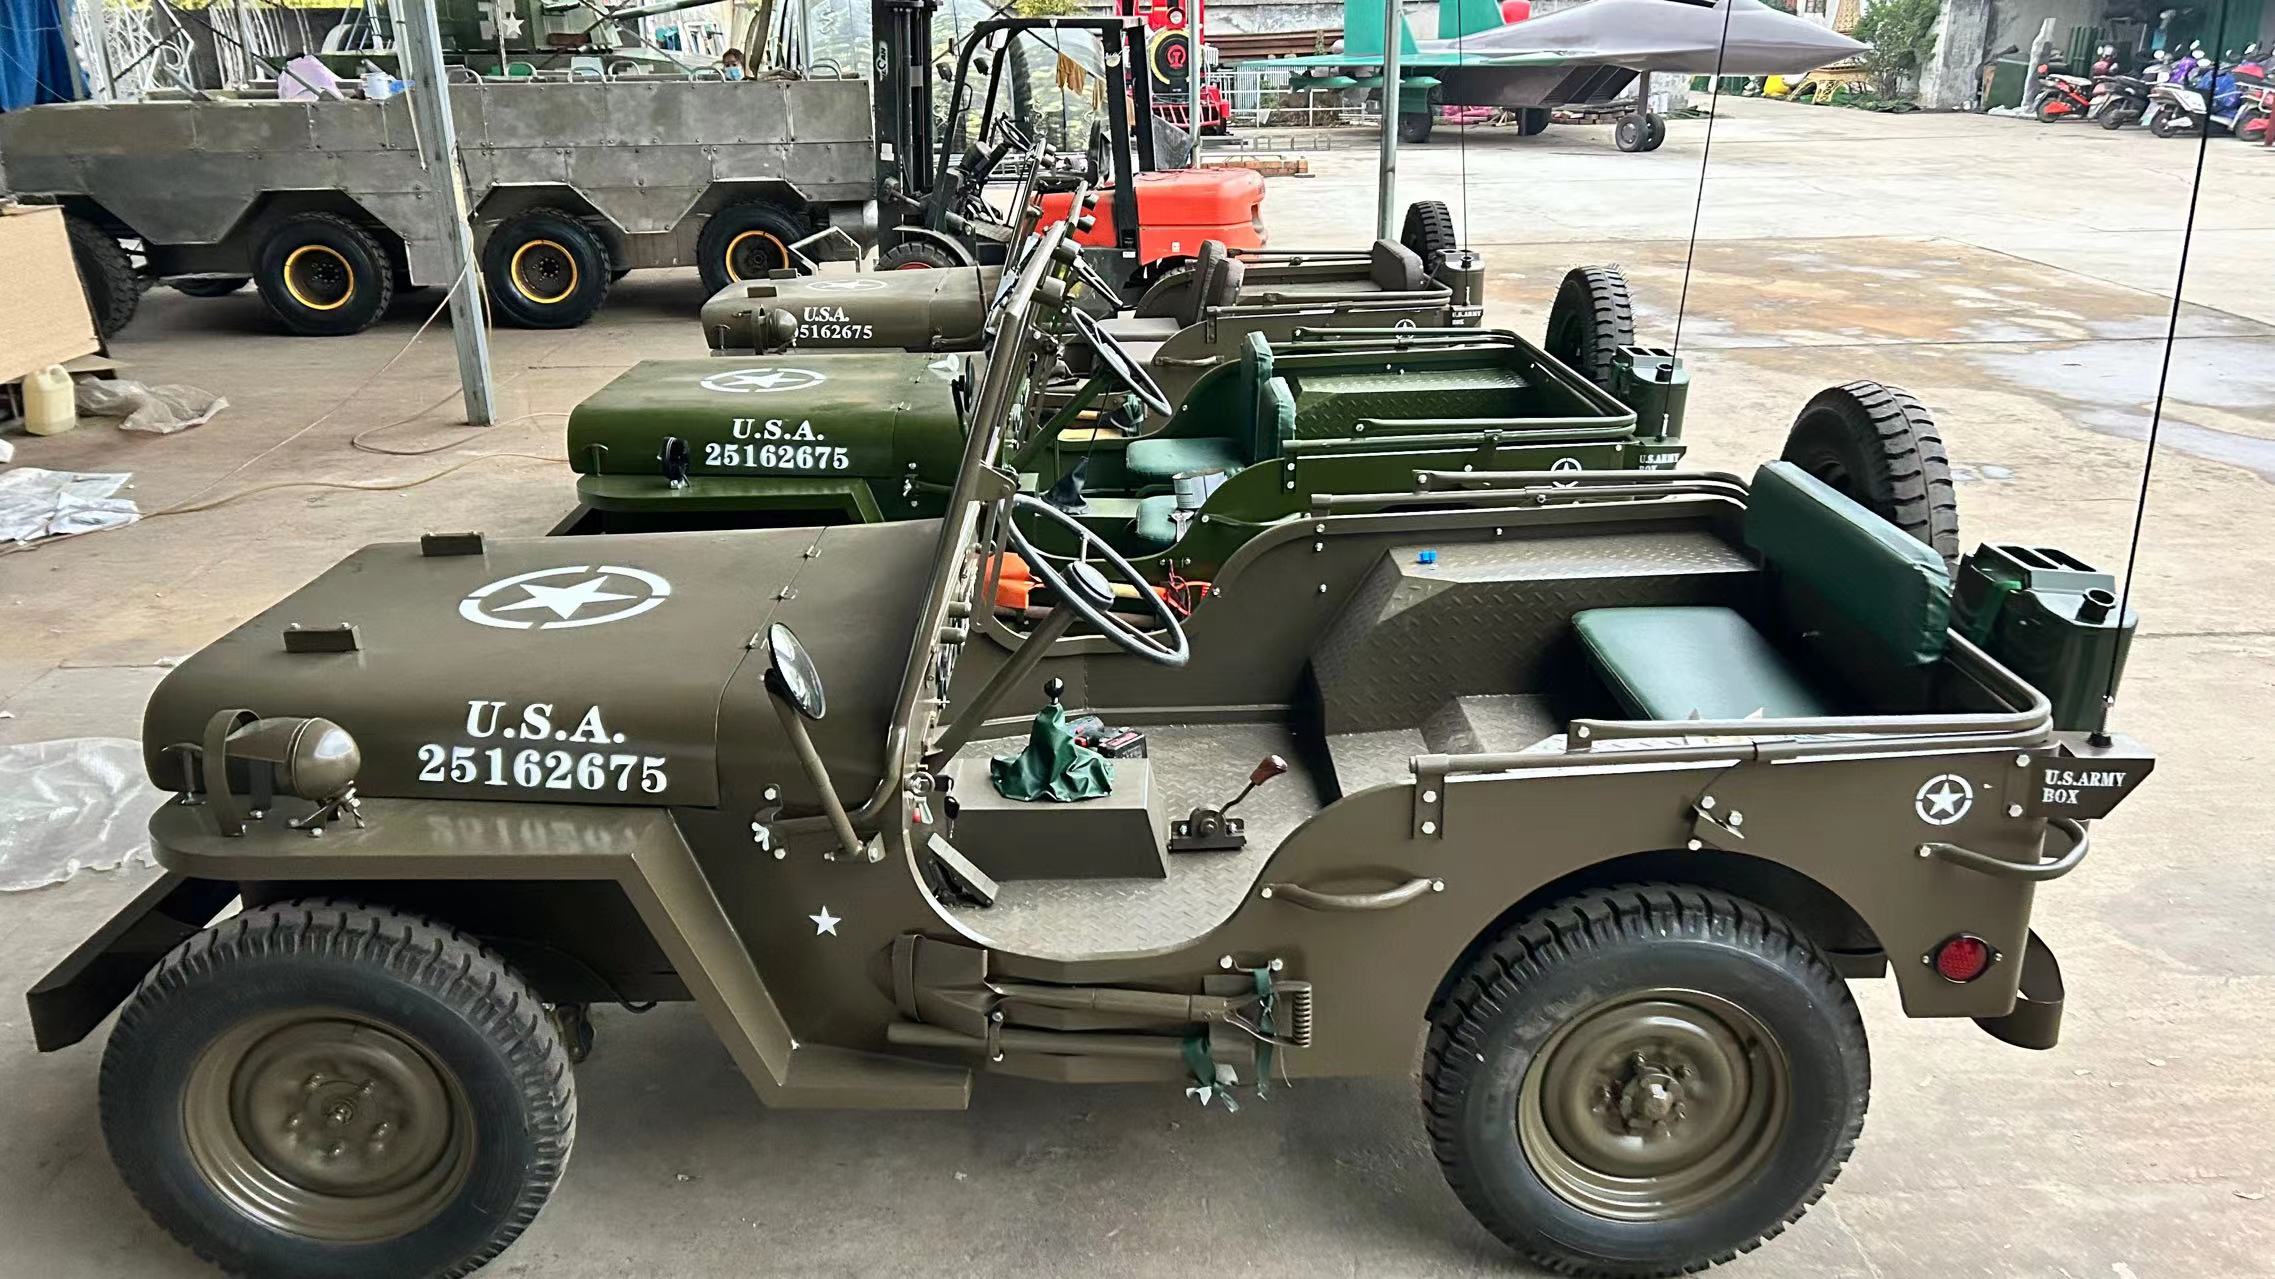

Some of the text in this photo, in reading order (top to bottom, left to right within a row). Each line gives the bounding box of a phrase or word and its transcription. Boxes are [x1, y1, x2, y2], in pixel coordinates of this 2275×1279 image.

[803, 306, 850, 322] U.S.A.
[794, 324, 873, 339] 5162675
[732, 418, 825, 441] U.S.A.
[705, 442, 850, 470] 25162675
[1639, 453, 1681, 464] U.S.ARMY
[466, 700, 626, 744] U.S.A.
[417, 743, 668, 793] 25162675
[2044, 768, 2127, 787] U.S.ARMY
[2042, 787, 2080, 804] BOX
